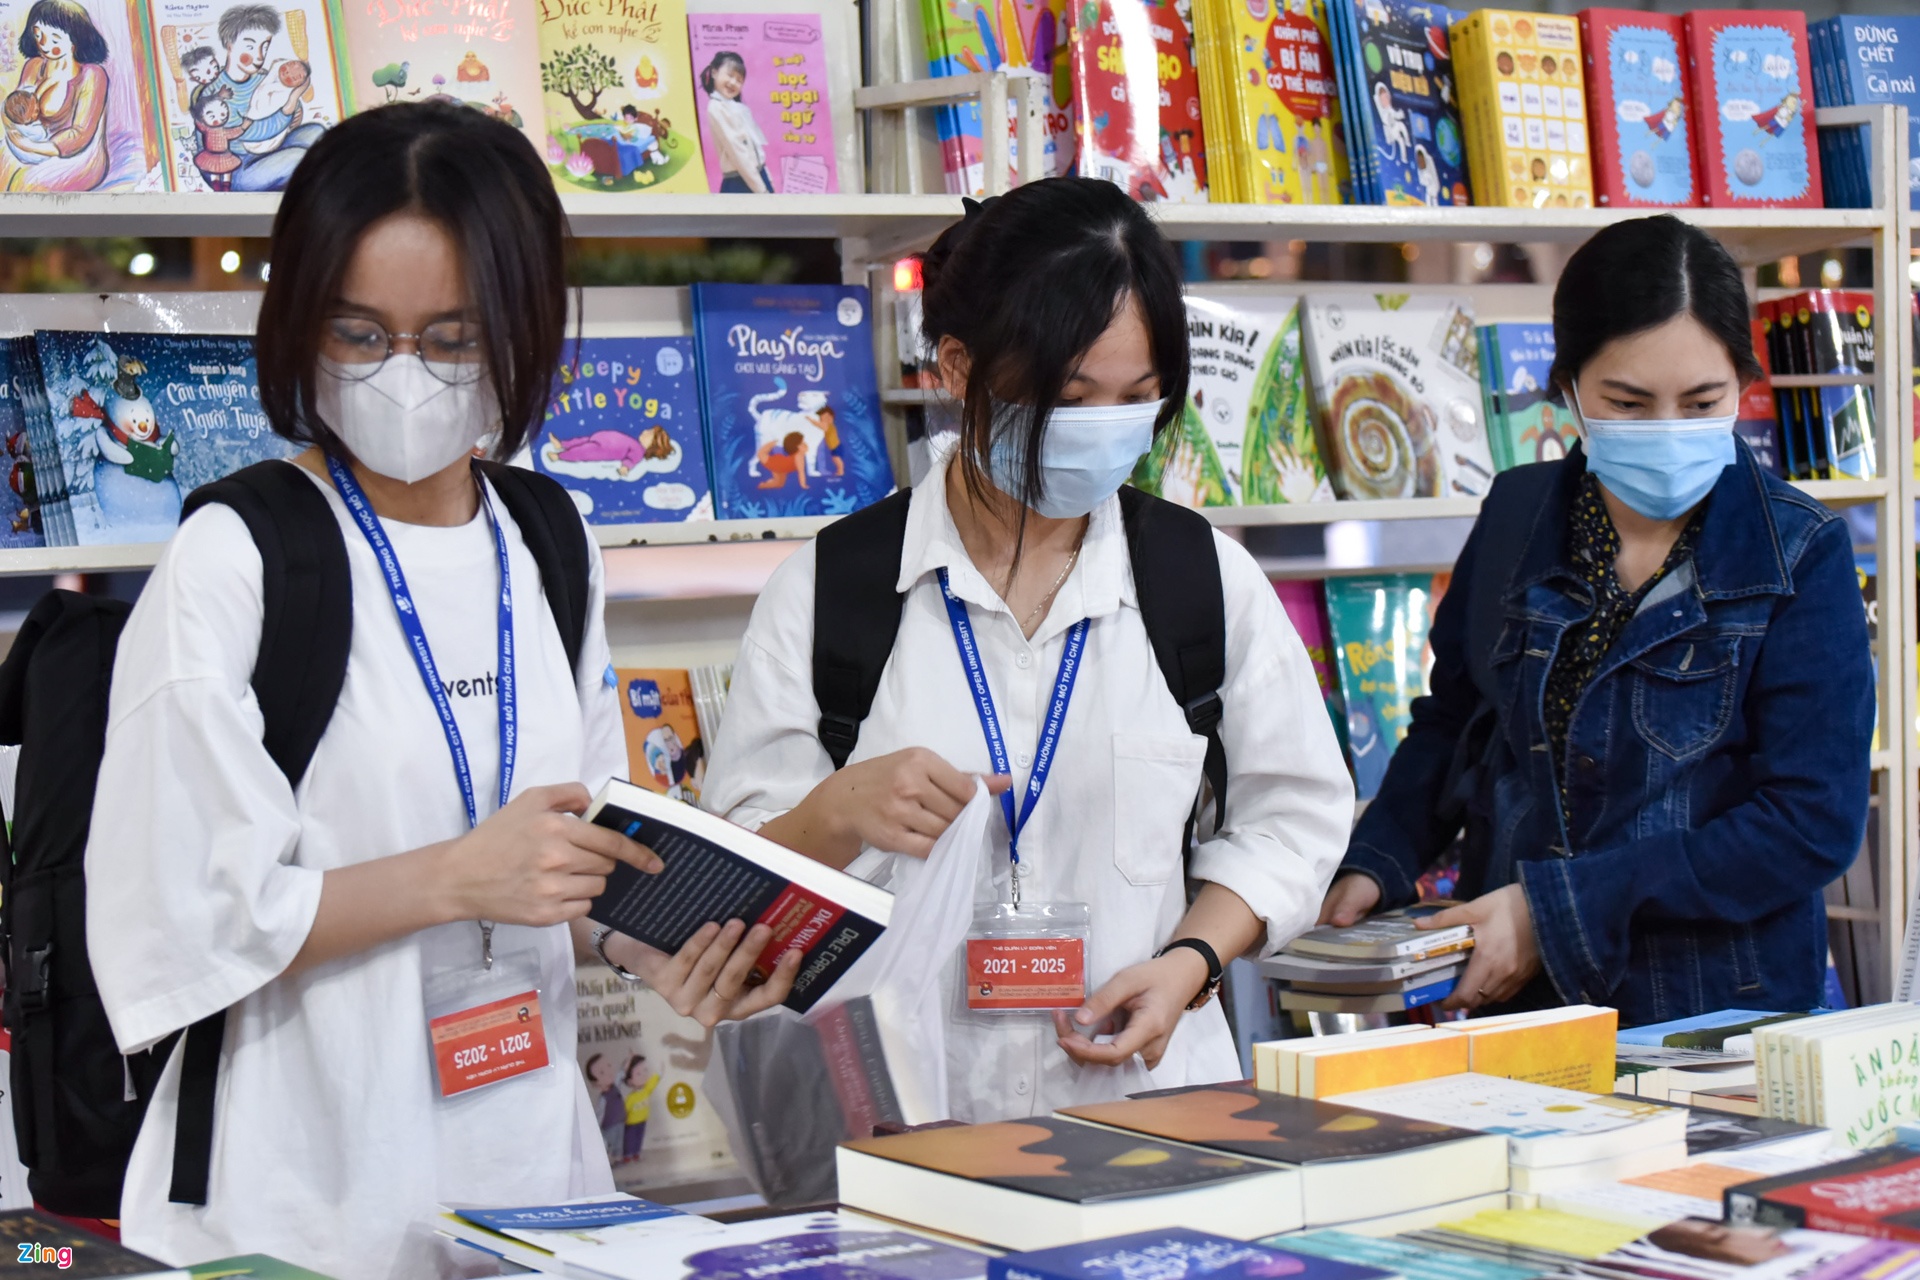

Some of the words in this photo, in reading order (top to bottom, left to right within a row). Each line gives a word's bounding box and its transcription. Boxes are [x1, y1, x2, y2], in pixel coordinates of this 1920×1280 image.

[562, 22, 579, 39] kể
[582, 24, 604, 35] con
[608, 22, 638, 43] nghe
[1854, 24, 1899, 44] ĐỪNG
[1280, 43, 1297, 70] BÍ
[1858, 42, 1894, 62] CHẾT
[778, 71, 807, 89] học
[771, 90, 819, 108] ngoại
[167, 381, 195, 406] Câu
[199, 376, 247, 406] chuyện
[613, 387, 672, 421] Yoga
[183, 407, 229, 439] Người
[231, 406, 272, 439] Tuyế
[358, 510, 376, 532] HỌC
[380, 547, 402, 589] TRƯỜNG
[503, 630, 512, 656] MINH
[957, 620, 979, 671] UNIVERSITY
[1068, 641, 1080, 659] CHÍ
[413, 634, 442, 693] UNIVERSITY
[972, 670, 987, 696] OPEN
[1057, 684, 1069, 699] MỞ
[436, 692, 452, 721] OPEN
[980, 696, 992, 716] CITY
[1053, 700, 1064, 719] HỌC
[447, 722, 461, 747] CITY
[505, 723, 516, 746] HỌC
[986, 716, 999, 741] MINH
[1048, 720, 1059, 736] ĐẠI
[992, 739, 1004, 757] CHI
[1037, 736, 1055, 773] TRƯỜNG
[455, 747, 467, 775] MINH
[997, 756, 1007, 772] HO
[983, 958, 1017, 974] 2021
[1031, 958, 1066, 973] 2025
[500, 1032, 532, 1056] 2021
[454, 1044, 488, 1069] 2025
